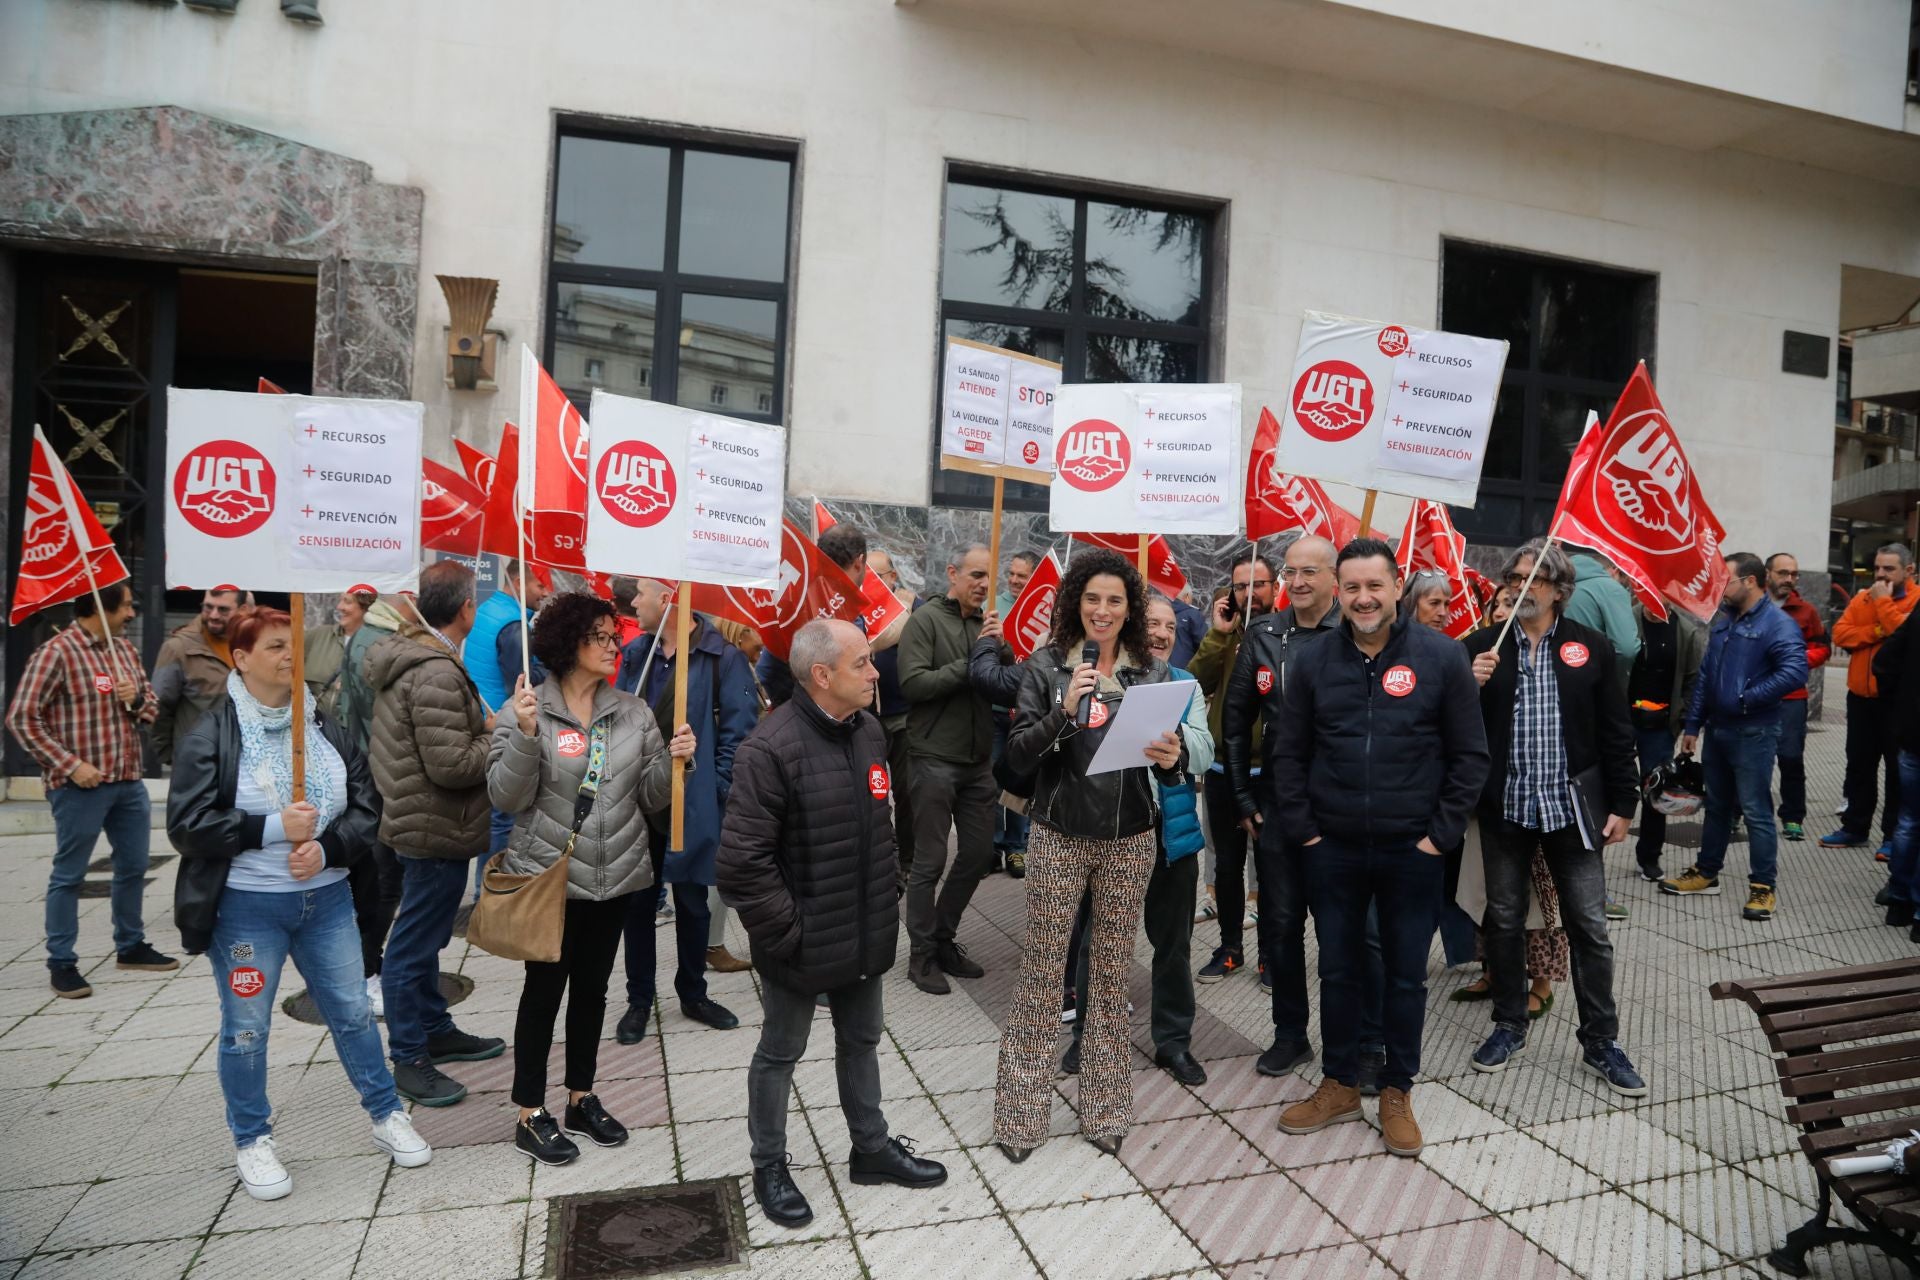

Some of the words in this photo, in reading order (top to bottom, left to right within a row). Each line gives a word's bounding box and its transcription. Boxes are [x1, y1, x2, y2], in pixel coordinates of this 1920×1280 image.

[1383, 329, 1405, 343] UGT
[1419, 352, 1473, 368] RECURSOS
[958, 366, 967, 374] LA
[968, 368, 1000, 382] SANIDAD
[959, 381, 997, 397] ATIENDE
[1018, 386, 1054, 406] STOP
[1302, 370, 1367, 410] UGT
[1412, 386, 1473, 403] SEGURIDAD
[952, 410, 961, 418] LA
[963, 412, 999, 426] VIOLENCIA
[1158, 412, 1207, 421] RECURSOS
[322, 430, 386, 445] RECURSOS
[957, 426, 992, 441] AGREDE
[1406, 421, 1473, 439] PREVENCIÓN
[712, 440, 760, 458] RECURSOS
[1064, 431, 1121, 459] UGT
[1156, 443, 1212, 451] SEGURIDAD
[1386, 440, 1473, 460] SENSIBILIZACIÓN
[185, 455, 264, 497] UGT
[320, 470, 392, 485] SEGURIDAD
[605, 451, 667, 493] UGT
[1155, 472, 1216, 483] PREVENCIÓN
[710, 475, 763, 492] SEGURIDAD
[1140, 493, 1220, 504] SENSIBILIZACIÓN
[318, 510, 398, 525] PREVENCIÓN
[708, 509, 766, 527] PREVENCIÓN
[298, 535, 402, 550] SENSIBILIZACIÓN
[692, 530, 770, 549] SENSIBILIZACIÓN
[1387, 670, 1412, 683] UGT
[233, 971, 259, 985] UGT
